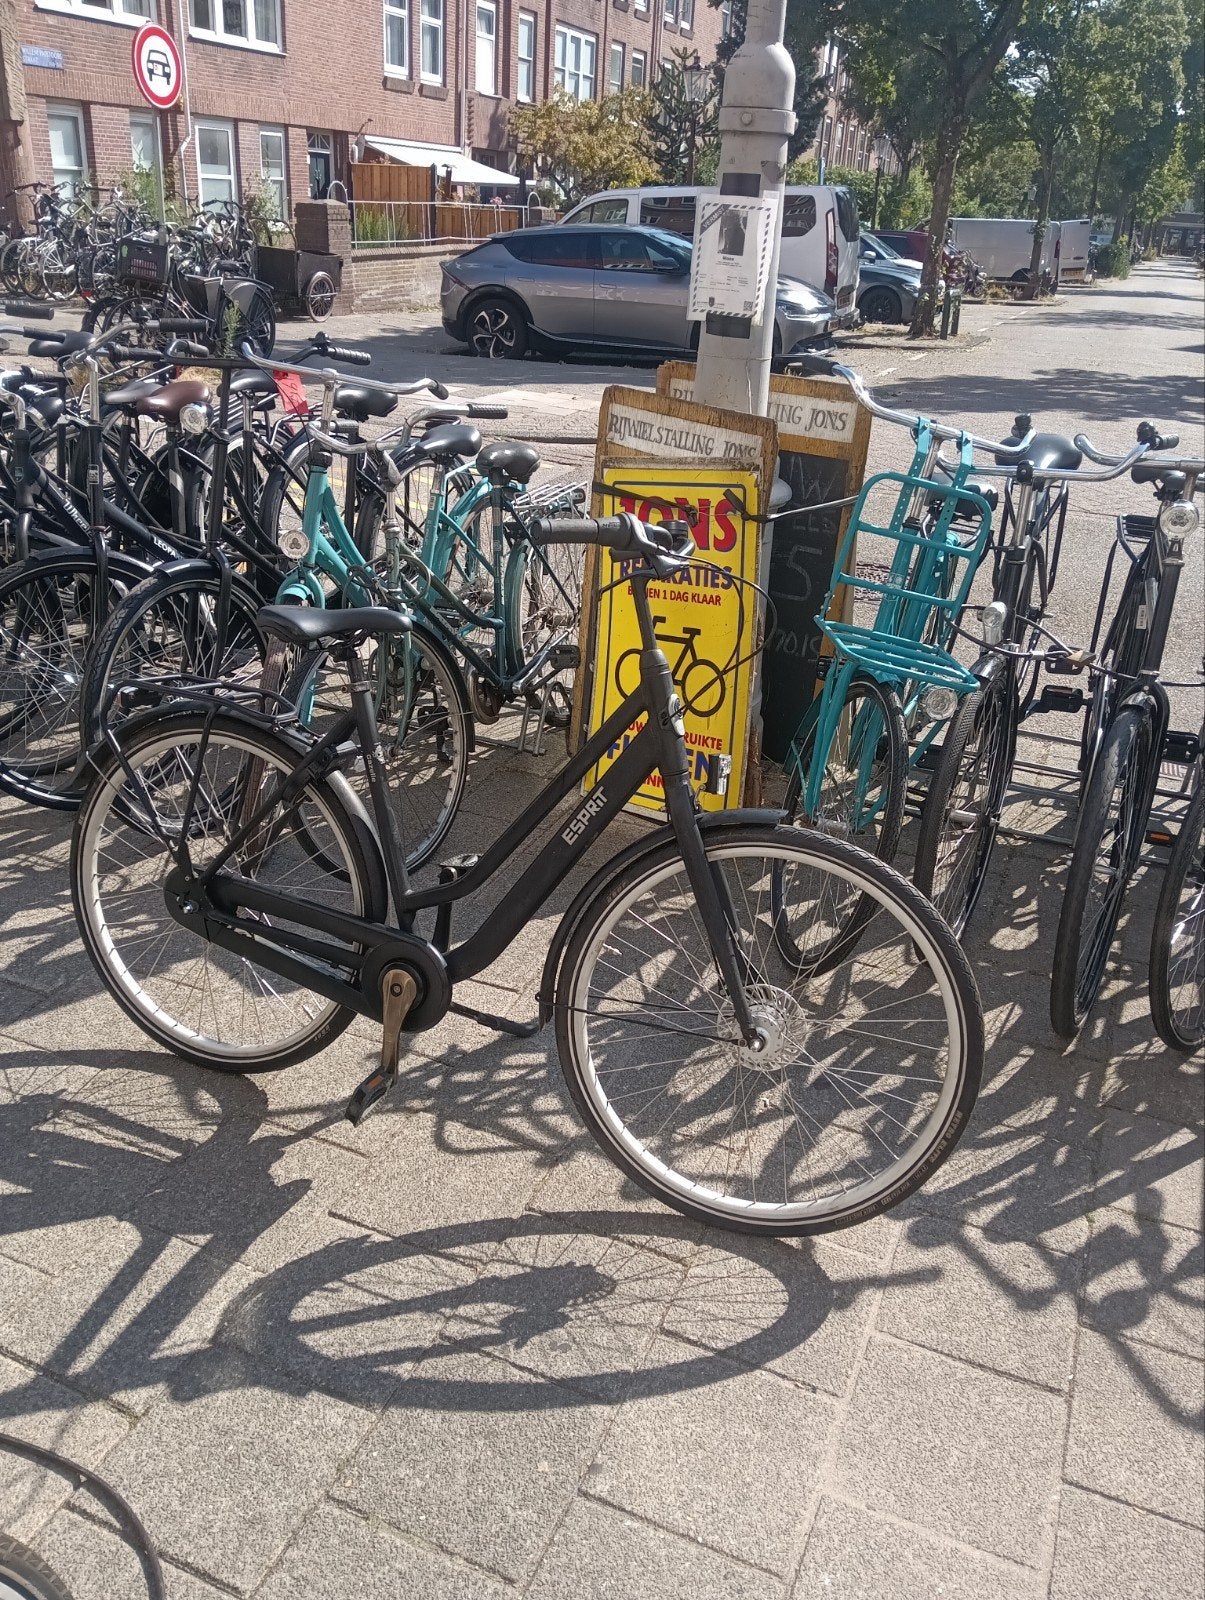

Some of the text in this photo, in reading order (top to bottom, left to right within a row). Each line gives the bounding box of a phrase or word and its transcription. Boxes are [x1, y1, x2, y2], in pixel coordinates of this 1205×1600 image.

[805, 408, 848, 431] JONS
[610, 413, 714, 456] RIJWIELSTALLING
[153, 535, 184, 559] LEOPA
[621, 557, 733, 589] RERATIES
[663, 589, 668, 600] 1
[670, 590, 689, 602] DAG
[691, 593, 721, 606] KLAAR
[684, 732, 723, 750] RUIKTE
[561, 785, 608, 846] ESPRIT
